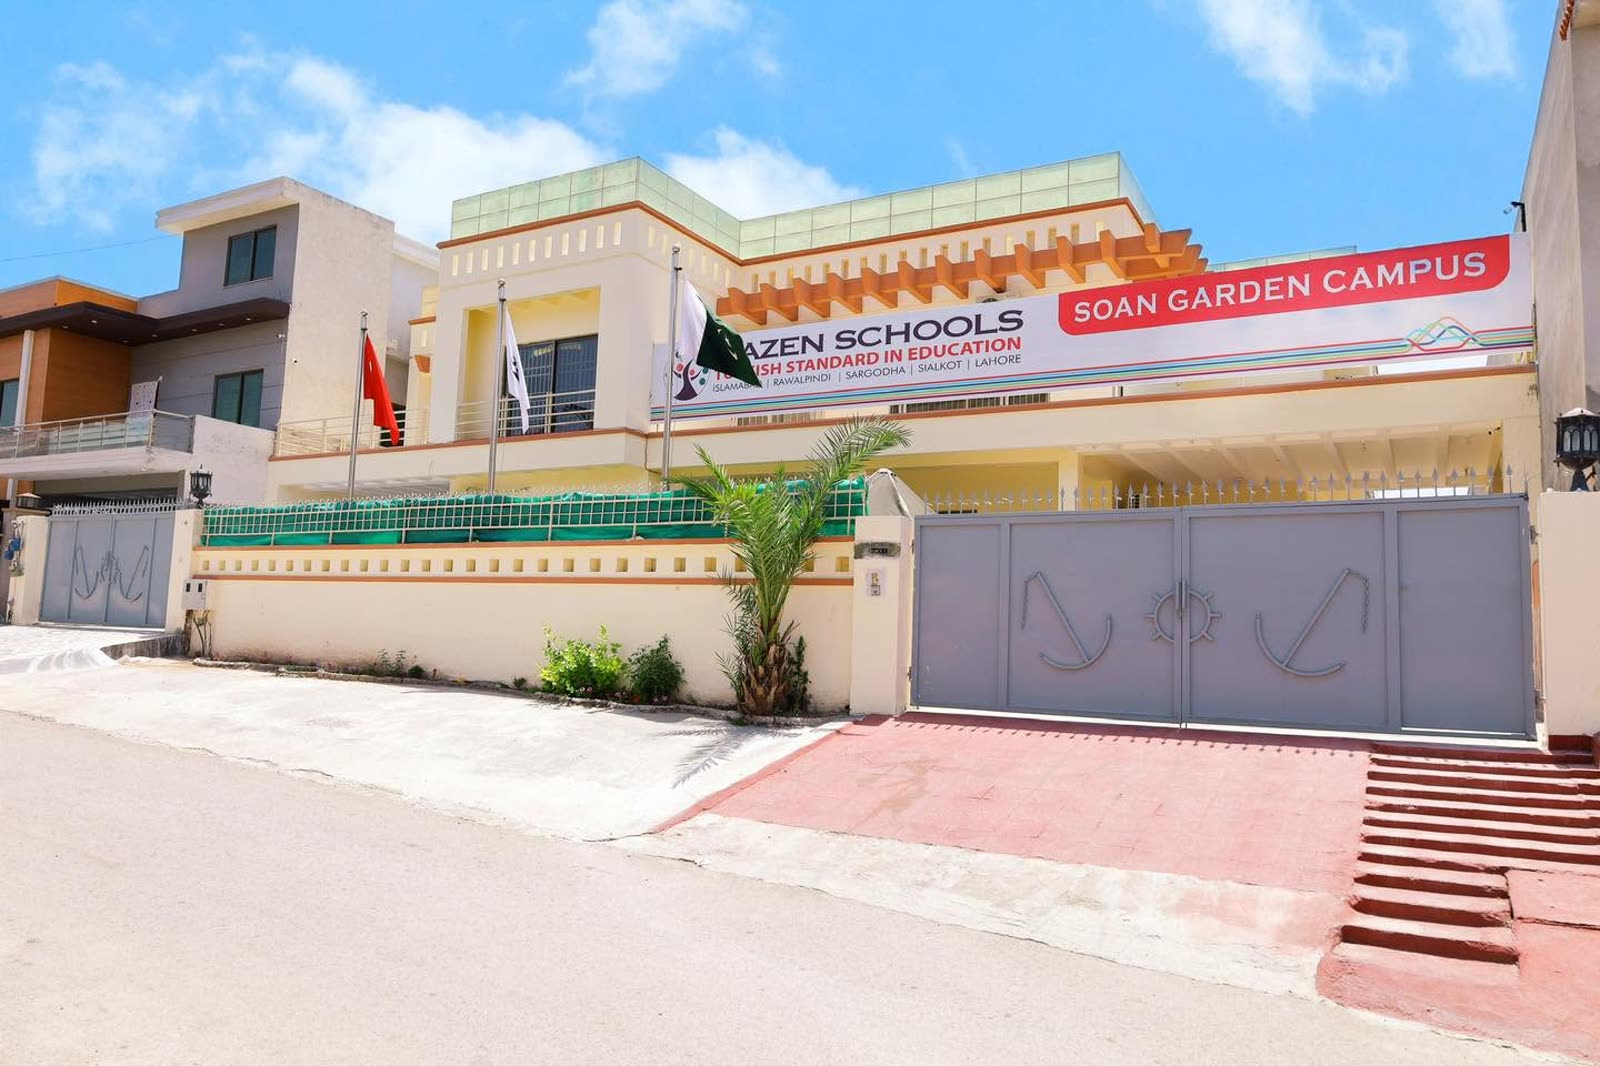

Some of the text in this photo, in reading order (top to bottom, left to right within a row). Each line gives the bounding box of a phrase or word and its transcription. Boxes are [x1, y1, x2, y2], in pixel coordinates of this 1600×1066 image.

[1073, 252, 1488, 323] SOAN GARDEN CAMPUS
[744, 309, 1024, 360] AZEN SCHOOLS
[786, 351, 880, 374] STANDARD
[884, 349, 903, 363] IN
[908, 336, 1022, 361] EDUCATION
[773, 373, 832, 387] RAWALPINDI
[845, 366, 907, 380] SARGODHA
[918, 360, 963, 373] SIALKOT
[975, 353, 1022, 368] LAHORE
